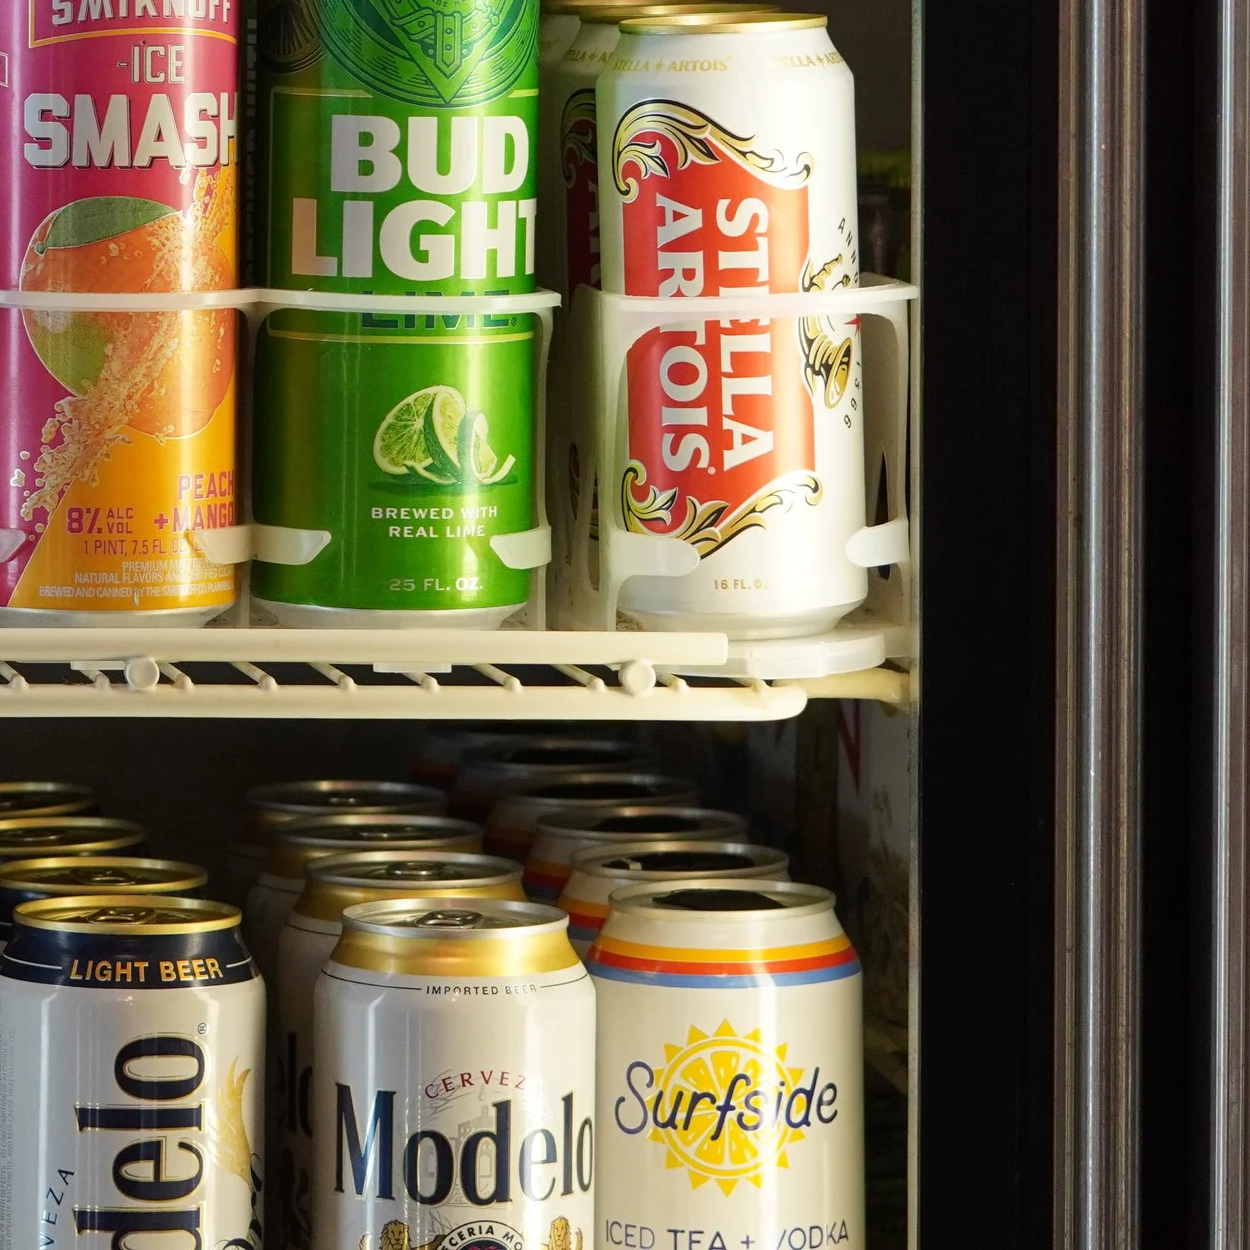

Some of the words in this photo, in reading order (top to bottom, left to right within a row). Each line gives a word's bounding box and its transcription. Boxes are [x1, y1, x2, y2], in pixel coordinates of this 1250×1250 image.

[667, 58, 729, 73] ARTOIS
[23, 92, 238, 170] SMASH
[330, 114, 530, 195] BUD
[291, 197, 538, 282] LIGHT
[178, 469, 235, 501] PEACH
[67, 507, 103, 534] 8%
[106, 507, 134, 520] ALC
[371, 507, 454, 520] BREWED
[461, 505, 498, 519] WITH
[106, 522, 134, 534] VOL
[389, 526, 439, 538] REAL
[445, 525, 485, 538] LIME
[83, 540, 89, 555] 1
[94, 539, 129, 557] PINT,
[132, 539, 149, 555] 7.5
[389, 579, 416, 591] 25
[423, 578, 450, 591] FL.
[455, 577, 484, 591] OZ.
[713, 579, 729, 590] 16
[733, 578, 751, 590] FL.
[69, 958, 149, 982] LIGHT
[159, 957, 224, 981] BEER
[426, 985, 499, 996] IMPORTED
[505, 983, 537, 994] BEER
[425, 1070, 530, 1100] CERVEZ
[615, 1061, 838, 1141] Surfside
[334, 1082, 594, 1206] Modelo
[606, 1220, 655, 1250] ICED
[667, 1229, 727, 1250] TEA
